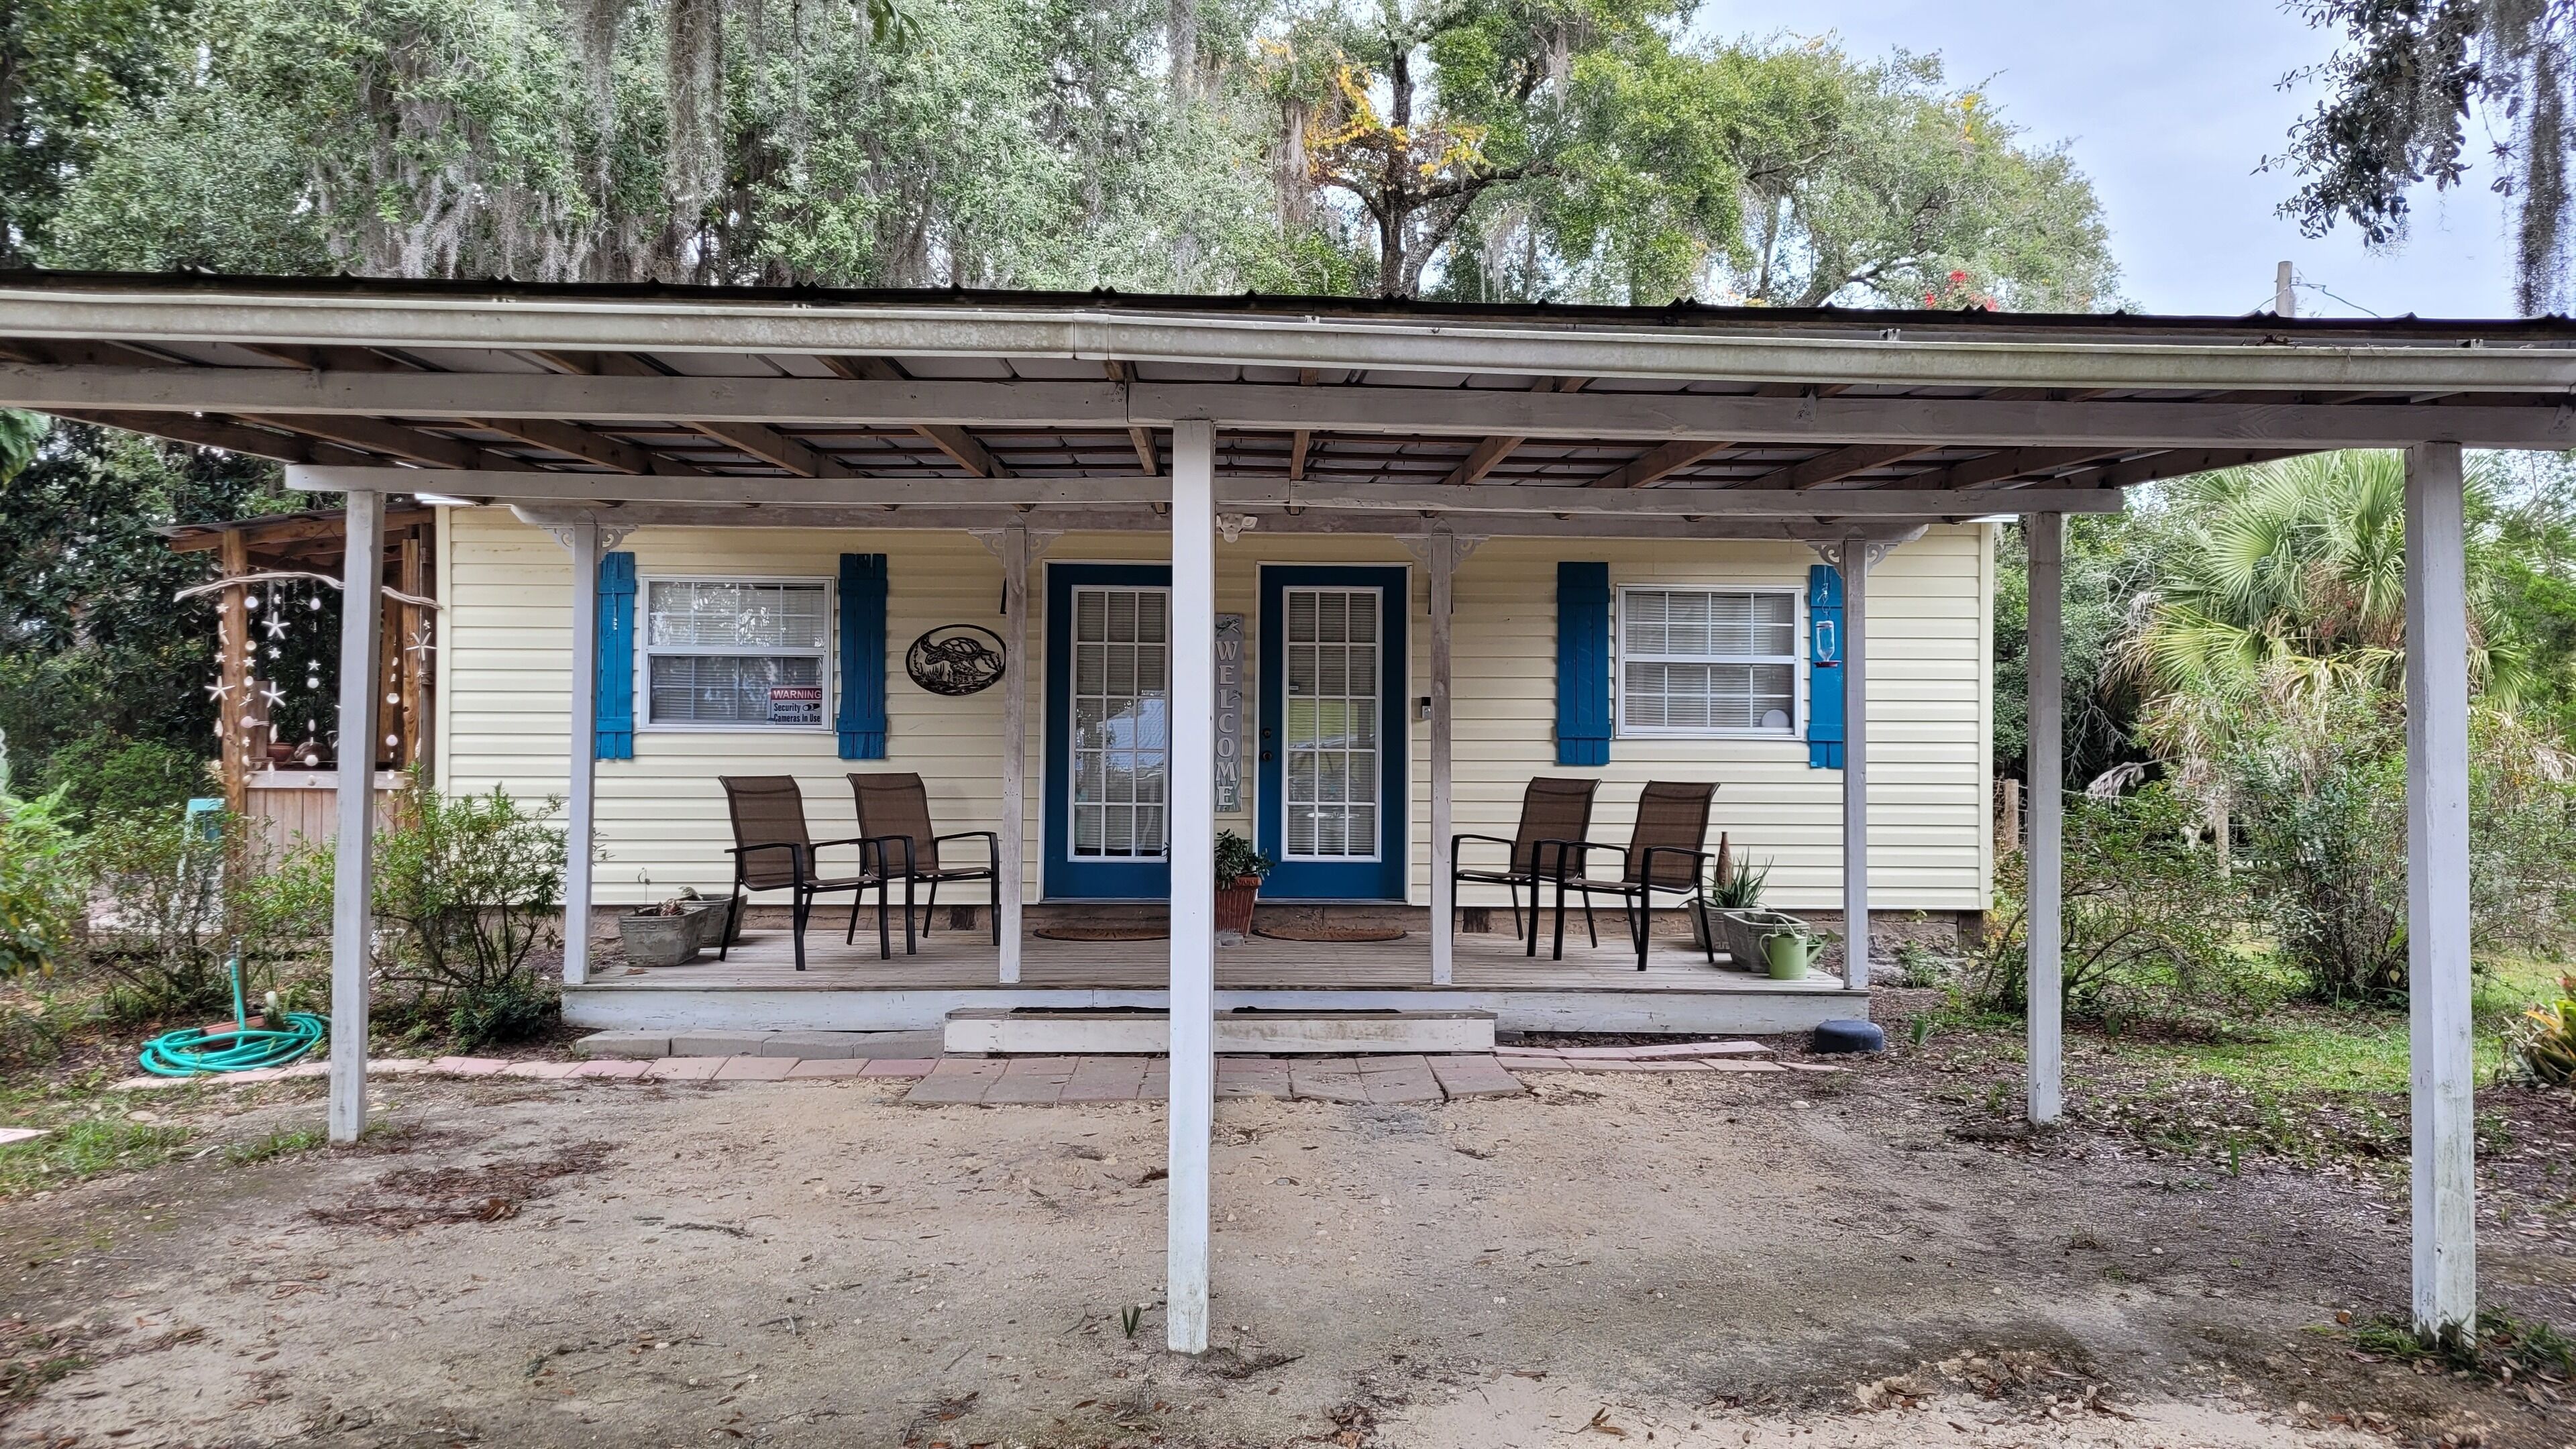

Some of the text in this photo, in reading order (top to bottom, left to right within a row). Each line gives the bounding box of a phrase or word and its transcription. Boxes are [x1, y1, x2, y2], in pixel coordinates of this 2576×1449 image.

[773, 690, 822, 699] WARNING
[773, 702, 801, 713] Security
[773, 714, 820, 722] Cameras In Use
[1215, 640, 1238, 806] WELCOME
